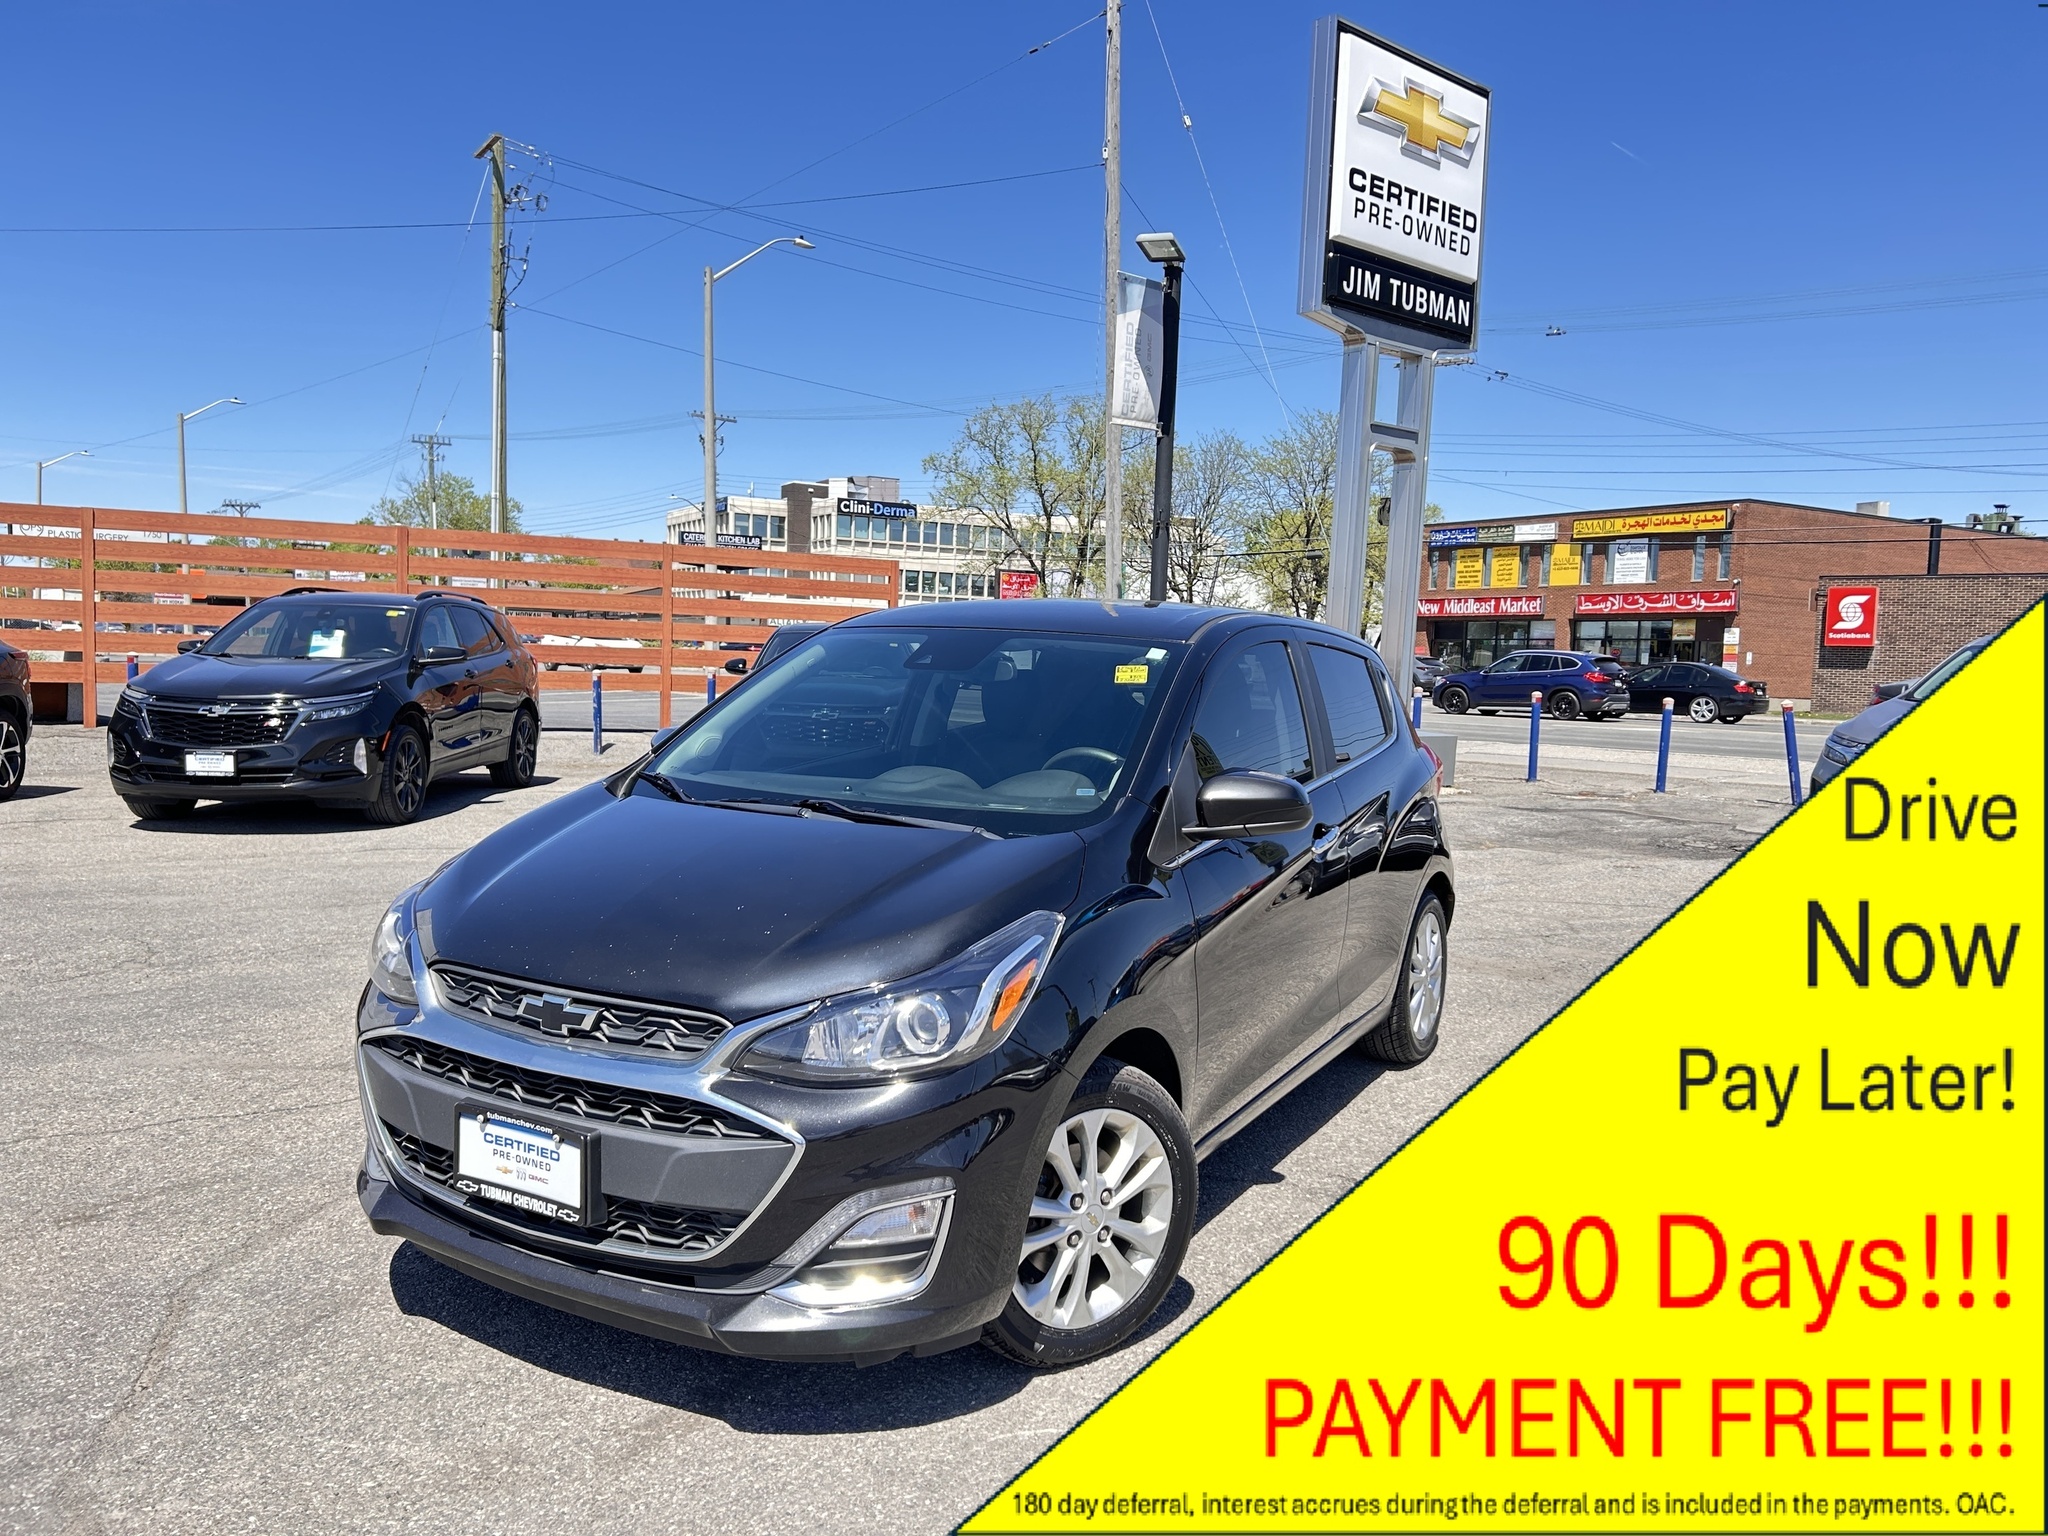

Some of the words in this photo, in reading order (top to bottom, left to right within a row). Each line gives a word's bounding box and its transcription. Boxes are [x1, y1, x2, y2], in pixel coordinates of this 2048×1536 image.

[1349, 167, 1477, 233] CERTIFIED
[1354, 197, 1471, 256] PRE-OWNED
[1342, 266, 1381, 301] JIM
[1389, 278, 1470, 326] TUBMAN
[1121, 322, 1135, 416] CERTIFIED
[840, 500, 916, 518] Clini-Derma
[1584, 519, 1615, 533] MAJDI
[1621, 518, 1653, 532] الهجرة
[1653, 513, 1692, 527] لخدمات
[1693, 513, 1725, 529] مجدي
[718, 535, 746, 545] KITCHEN
[747, 537, 760, 546] LAB
[1417, 600, 1440, 614] New
[1443, 598, 1496, 614] Middleast
[1499, 597, 1541, 613] Market
[486, 1111, 553, 1134] tubmanchev.com
[483, 1132, 560, 1162] CERTIFIED
[492, 1148, 552, 1172] PRE-OWNED
[528, 1173, 549, 1185] GMC
[480, 1184, 513, 1204] TUBMAN
[513, 1193, 558, 1217] CHEVROLET
